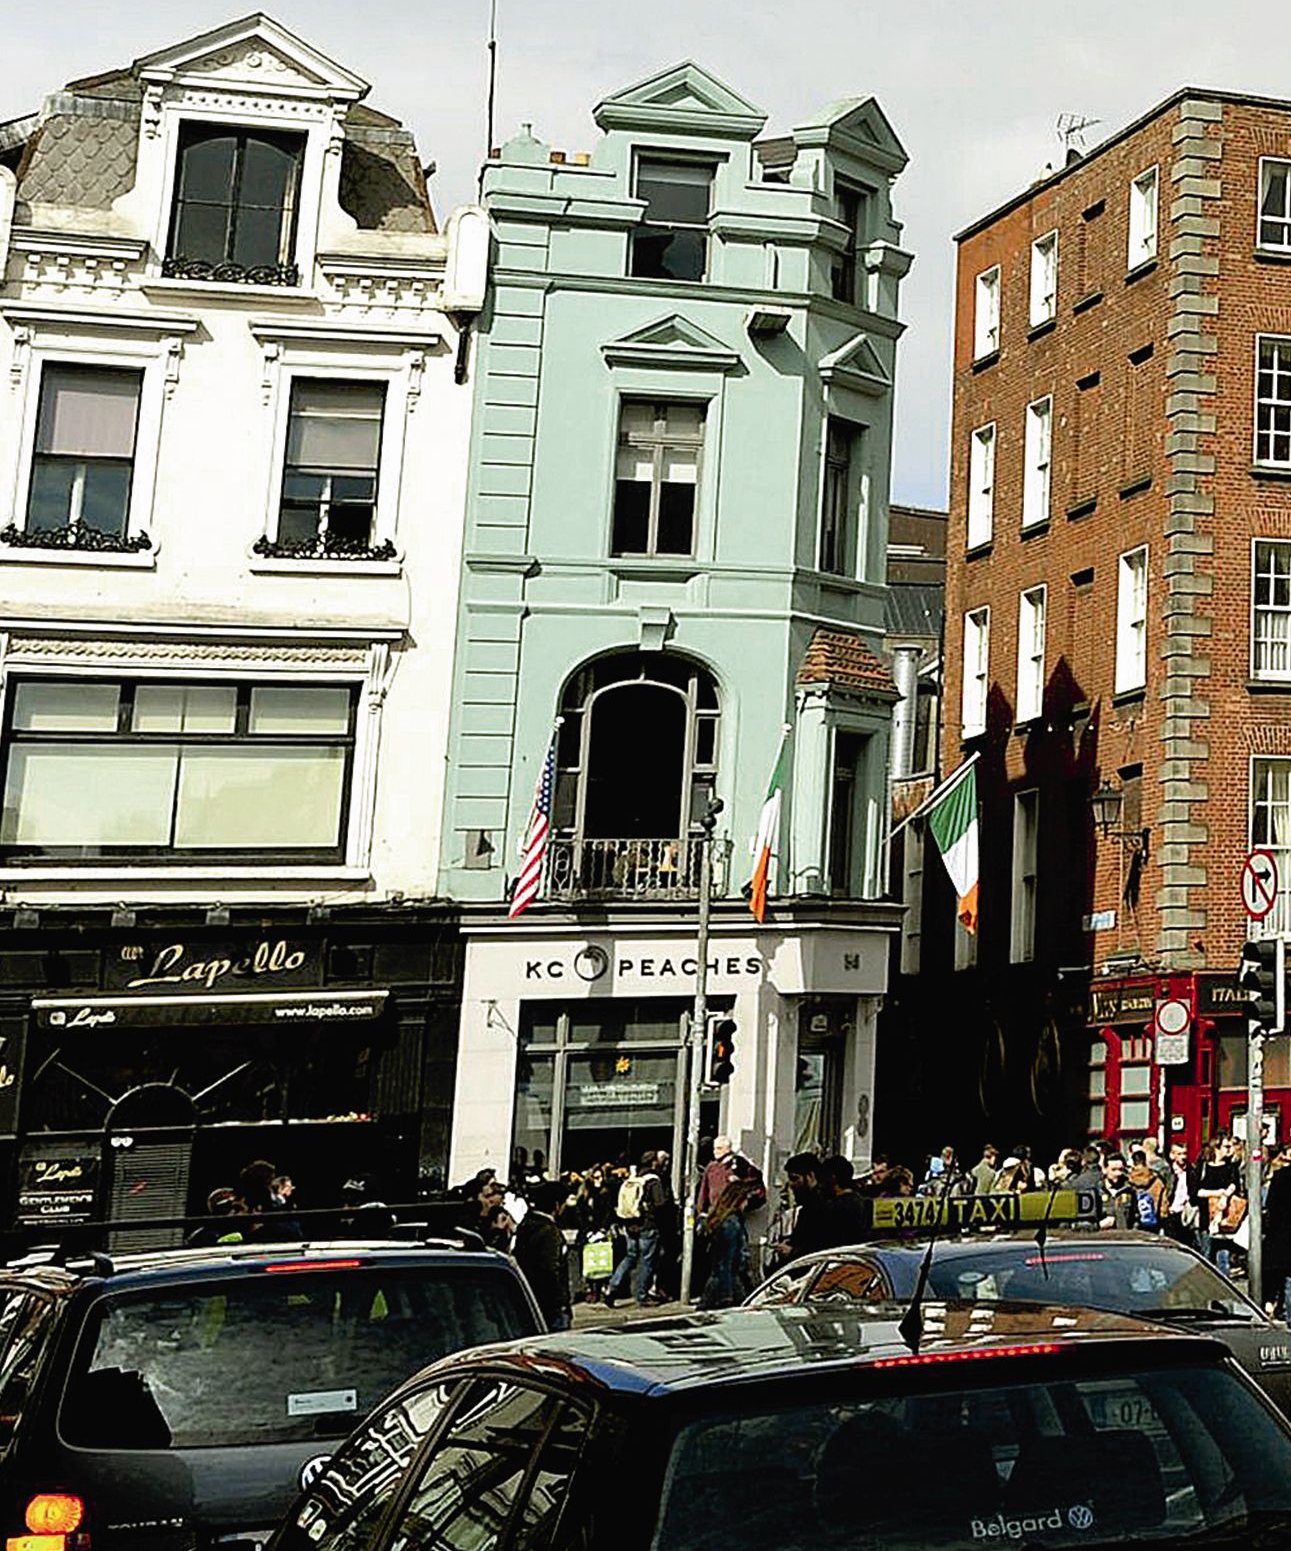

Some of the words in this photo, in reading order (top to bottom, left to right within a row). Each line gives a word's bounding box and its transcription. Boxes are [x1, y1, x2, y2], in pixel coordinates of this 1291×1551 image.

[526, 960, 564, 979] KC
[618, 956, 762, 978] PEACHES
[952, 1198, 1016, 1224] TAXI
[971, 1509, 1063, 1539] Belgard
